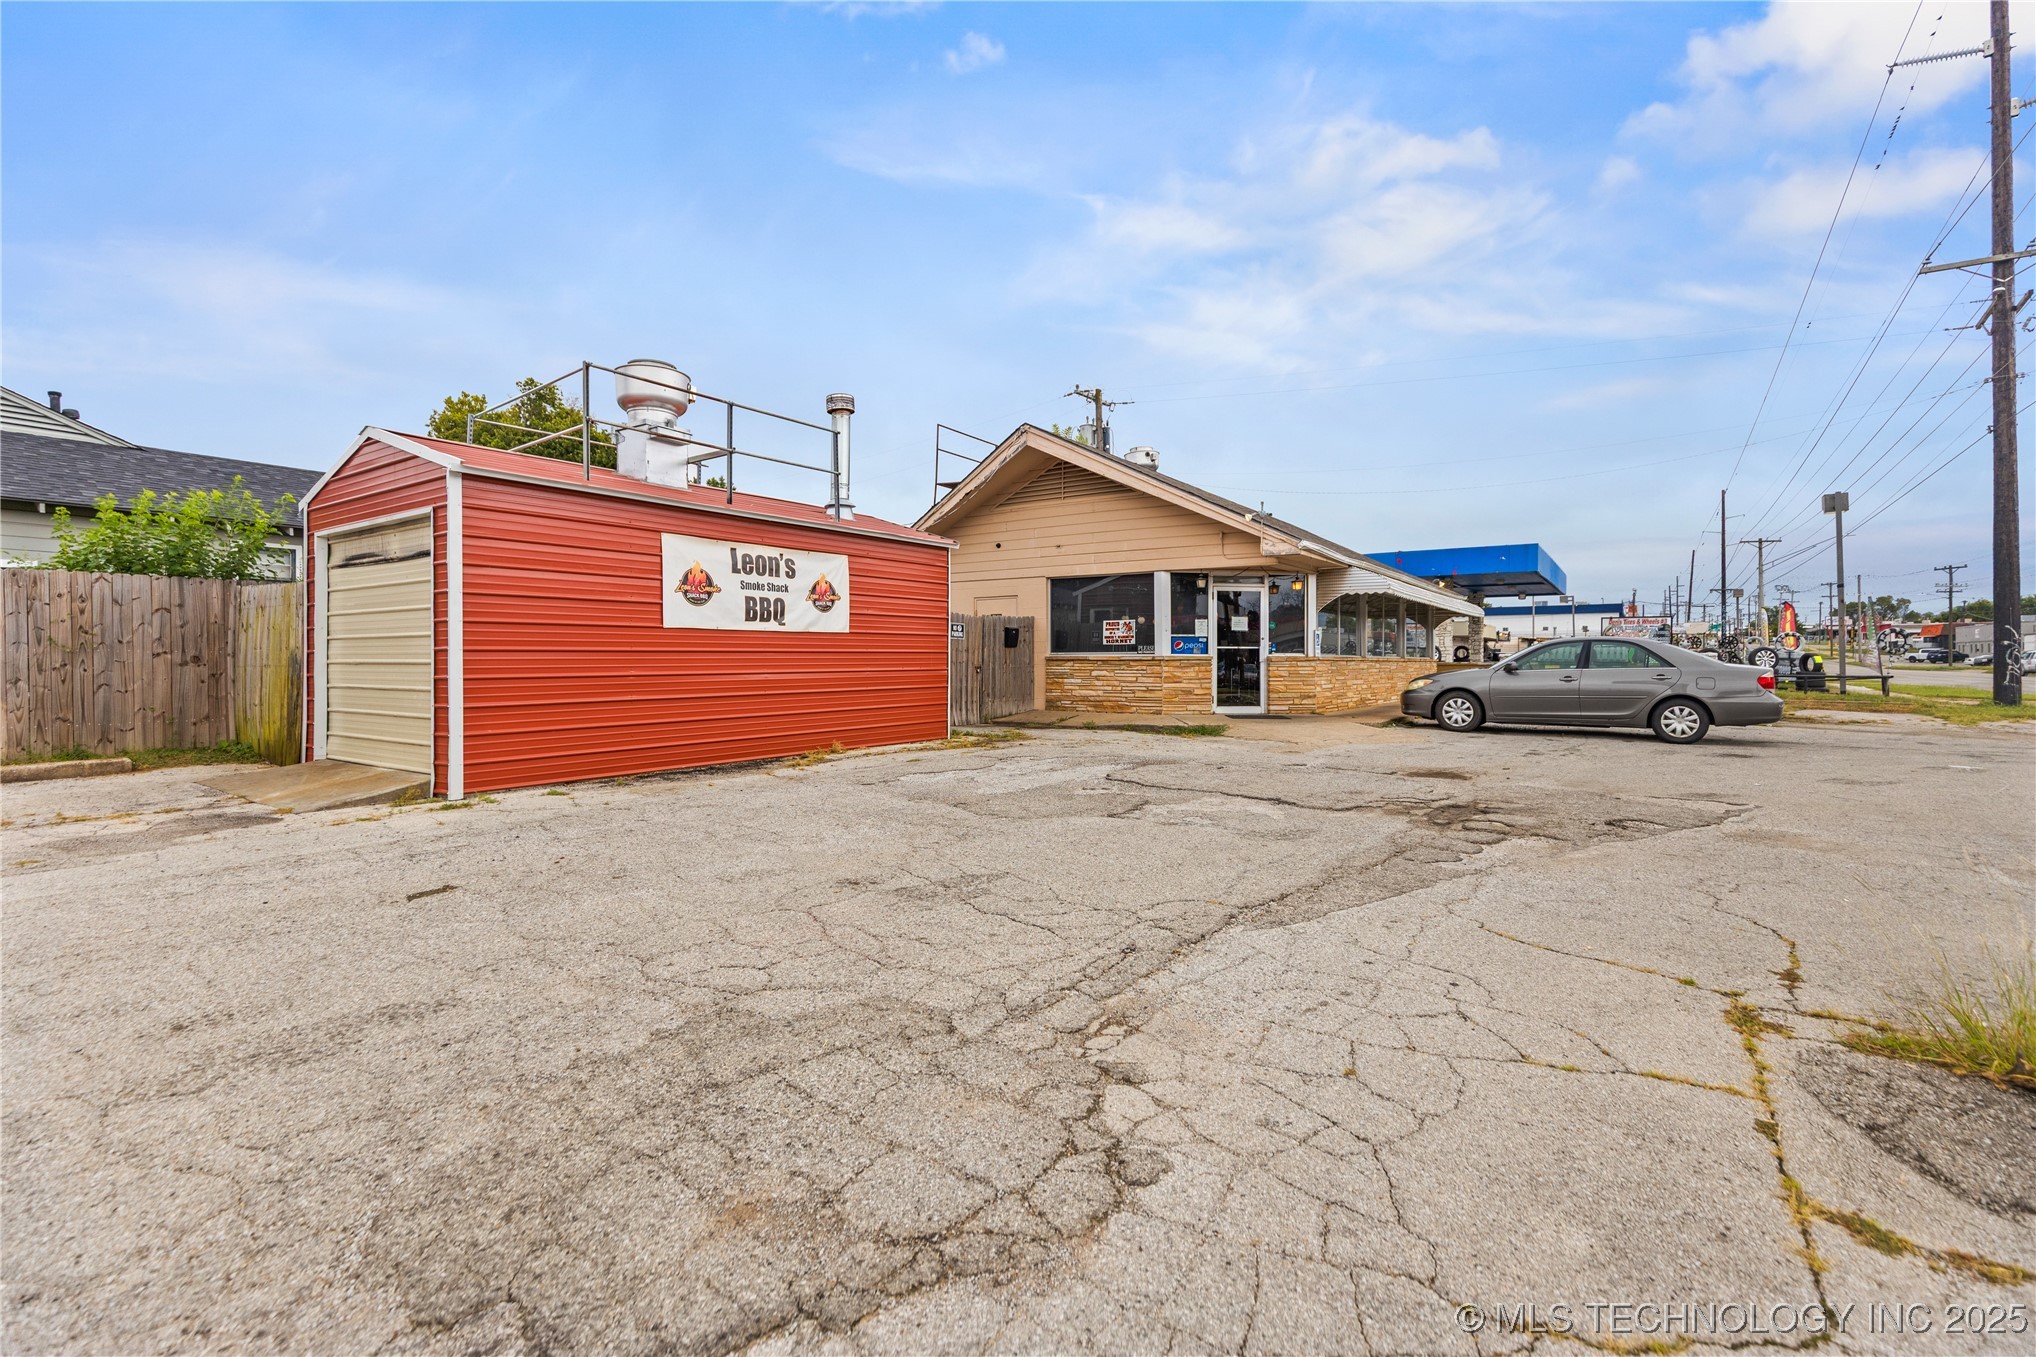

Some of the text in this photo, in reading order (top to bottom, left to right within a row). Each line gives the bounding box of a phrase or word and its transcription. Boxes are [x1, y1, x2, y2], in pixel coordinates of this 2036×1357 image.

[730, 547, 796, 579] Leon's
[740, 580, 789, 593] Smoke Shack
[744, 595, 786, 626] BBQ
